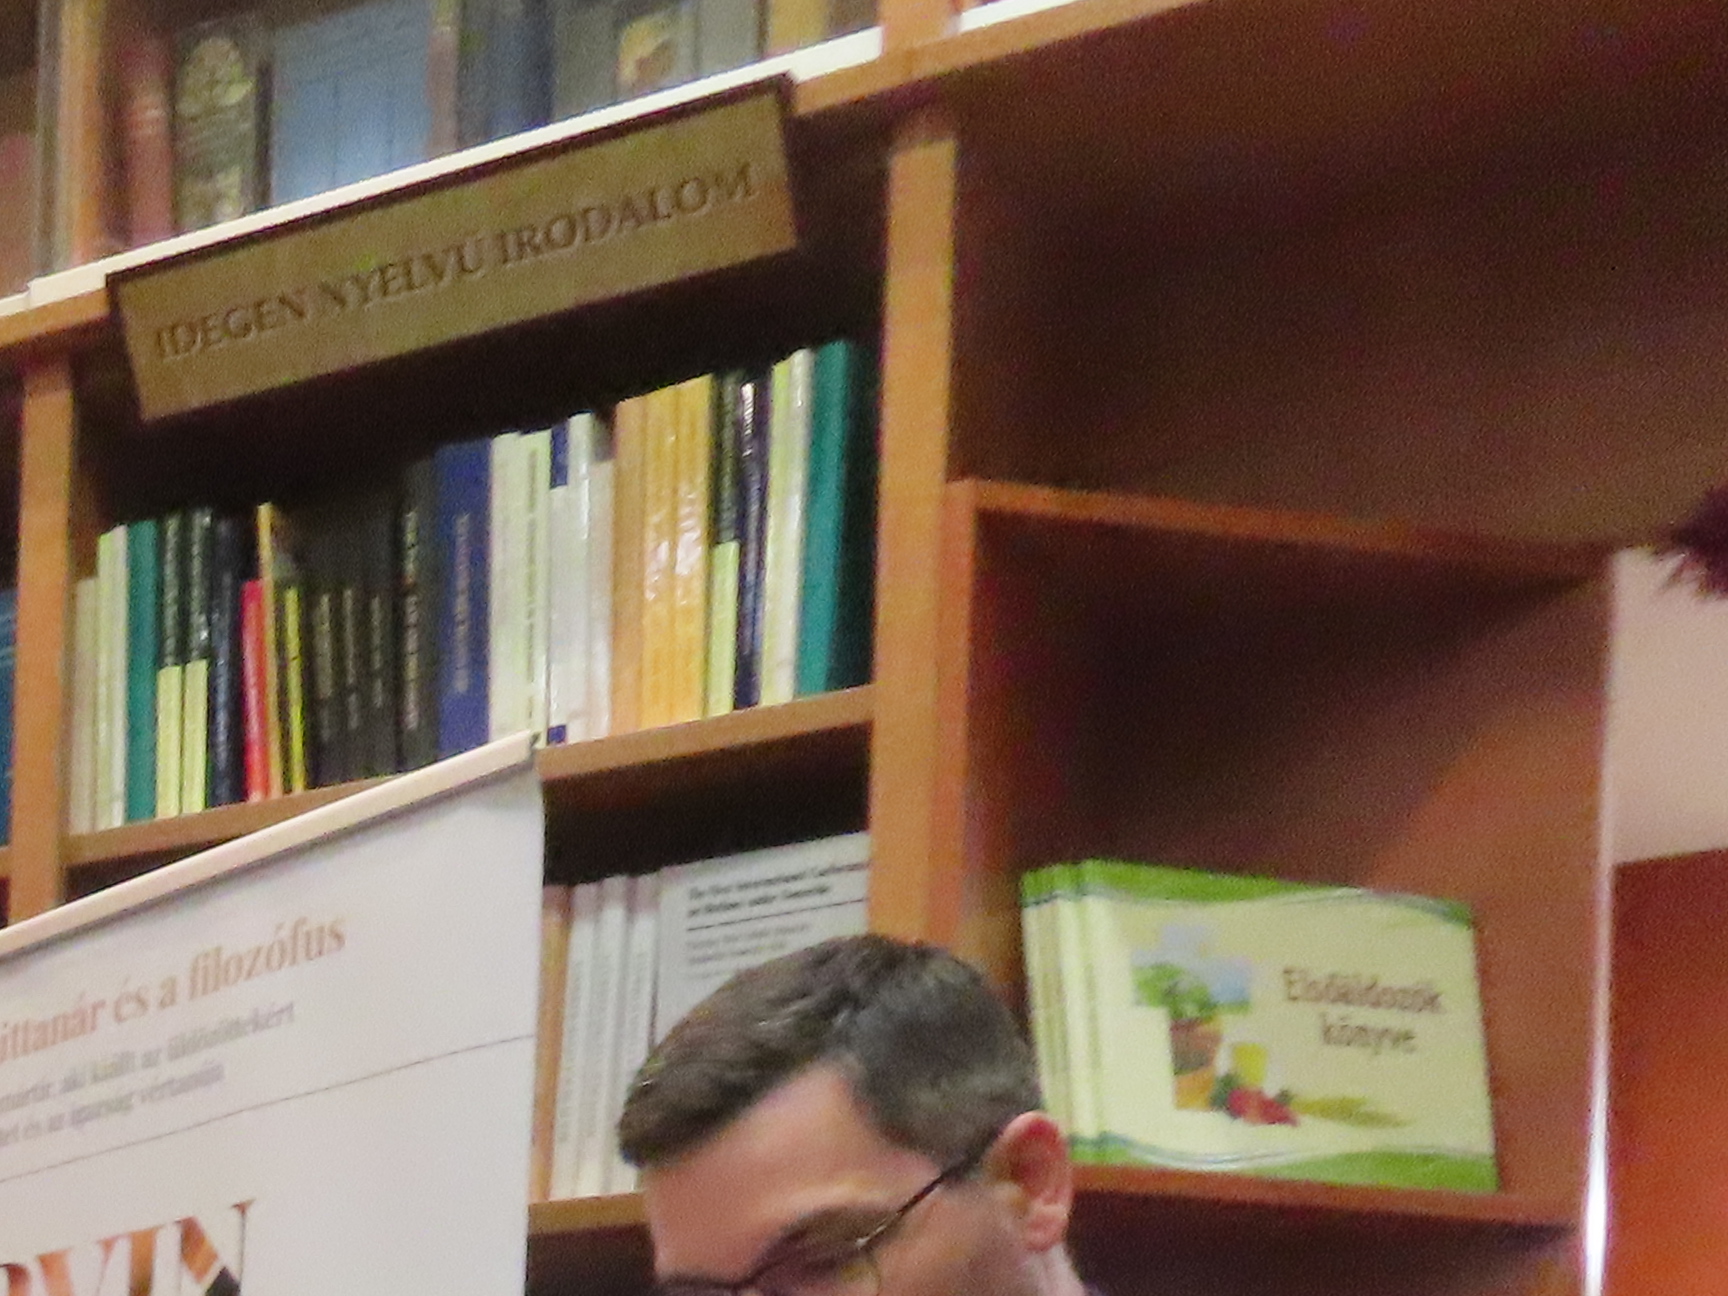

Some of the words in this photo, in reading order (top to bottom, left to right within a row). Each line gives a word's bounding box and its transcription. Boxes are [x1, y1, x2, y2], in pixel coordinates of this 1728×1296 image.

[155, 286, 311, 361] IDEGEN
[495, 160, 759, 270] IRODALOM
[112, 974, 150, 1025] és
[157, 978, 179, 1012] a
[188, 914, 347, 999] filozófus
